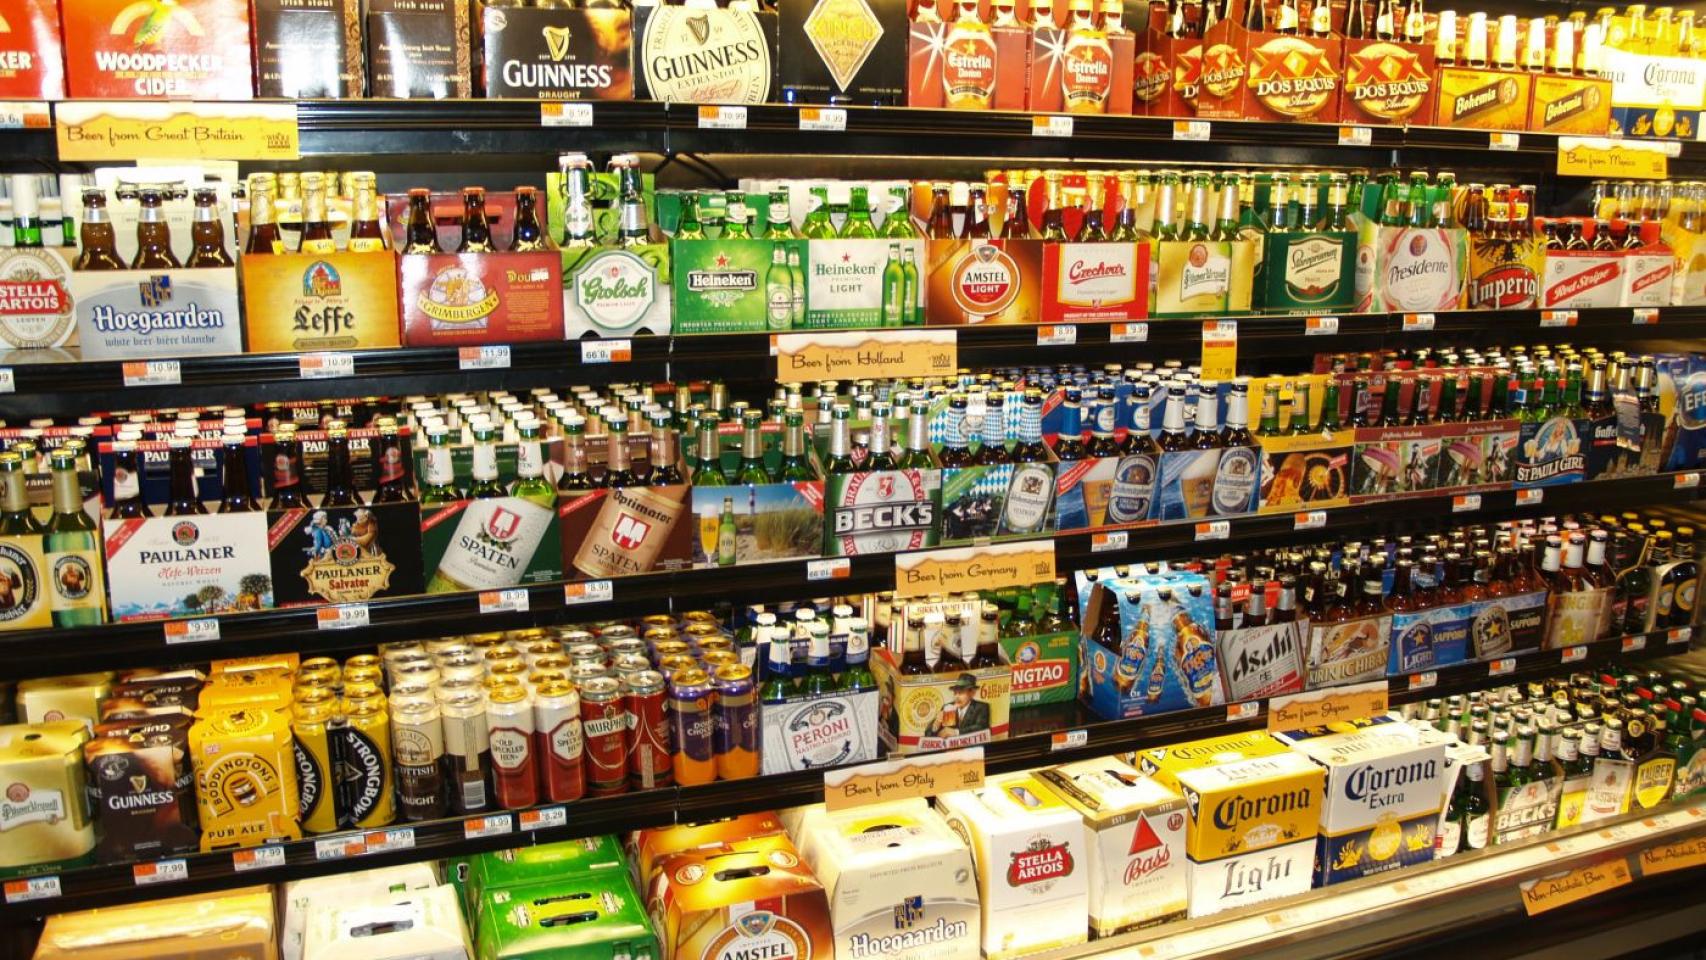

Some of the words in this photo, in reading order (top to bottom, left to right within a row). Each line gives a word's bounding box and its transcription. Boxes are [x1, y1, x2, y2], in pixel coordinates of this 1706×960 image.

[96, 50, 223, 72] WOODPECKER
[652, 40, 759, 82] GUINNESS
[948, 52, 992, 69] Estrella
[1067, 58, 1107, 75] Estrella
[503, 60, 612, 88] GUINNESS
[1644, 63, 1695, 87] Corona
[539, 90, 580, 98] DRAUGHT
[1257, 80, 1291, 96] DOS
[1294, 77, 1335, 93] EQUIS
[1354, 84, 1387, 100] DOS
[1389, 81, 1429, 96] EQUIS
[1454, 88, 1497, 115] Bohemia
[66, 126, 104, 141] Beer
[108, 125, 140, 146] from
[144, 126, 190, 141] Great
[190, 126, 244, 141] Britain
[692, 273, 752, 287] Heineken
[815, 263, 876, 276] Heineken
[964, 271, 1007, 282] AMSTEL
[1390, 259, 1449, 287] Presidente
[0, 285, 58, 297] STELLA
[581, 276, 648, 305] Grolsch
[830, 283, 864, 294] LIGHT
[970, 284, 1000, 294] LIGHT
[0, 297, 59, 310] ARTOIS
[422, 298, 495, 320] GRIMBERGEN
[92, 302, 224, 335] Hoegaarden
[292, 304, 355, 336] Leffe
[791, 354, 823, 369] Beer
[825, 354, 852, 372] from
[857, 351, 905, 365] Holland
[1517, 467, 1532, 482] ST
[1531, 461, 1561, 479] PAULI
[1560, 456, 1584, 471] GIRL
[612, 490, 673, 524] Optimator
[834, 502, 933, 533] BECK'S
[140, 546, 237, 565] PAULANER
[459, 535, 520, 570] SPATEN
[591, 543, 642, 572] SPATEN
[158, 566, 223, 579] Hefe-Weizen
[314, 565, 382, 580] PAULANER
[907, 568, 936, 585] Beer
[938, 567, 965, 586] from
[967, 563, 1018, 577] Germany
[328, 578, 370, 590] Salvator
[1232, 628, 1294, 682] Asahi
[1012, 664, 1064, 685] NGTAO
[791, 717, 850, 749] PERONI
[1171, 737, 1253, 762] Corona
[213, 757, 273, 806] BODDINGTONS
[346, 731, 381, 823] STRONGBOW
[844, 784, 873, 797] Beer
[875, 780, 900, 797] from
[903, 773, 935, 789] Italy
[1344, 758, 1436, 802] Corona
[108, 791, 174, 810] GUINNESS
[1212, 786, 1311, 832] Corona
[1369, 791, 1405, 810] Extra
[1496, 802, 1557, 829] BECK'S
[208, 828, 236, 839] PUB
[241, 823, 267, 834] ALE
[1017, 851, 1063, 869] STELLA
[1017, 861, 1064, 880] ARTOIS
[1123, 844, 1171, 886] Bass
[1220, 855, 1293, 899] Light
[850, 917, 967, 960] Hoegaarden
[721, 941, 789, 960] AMSTEL
